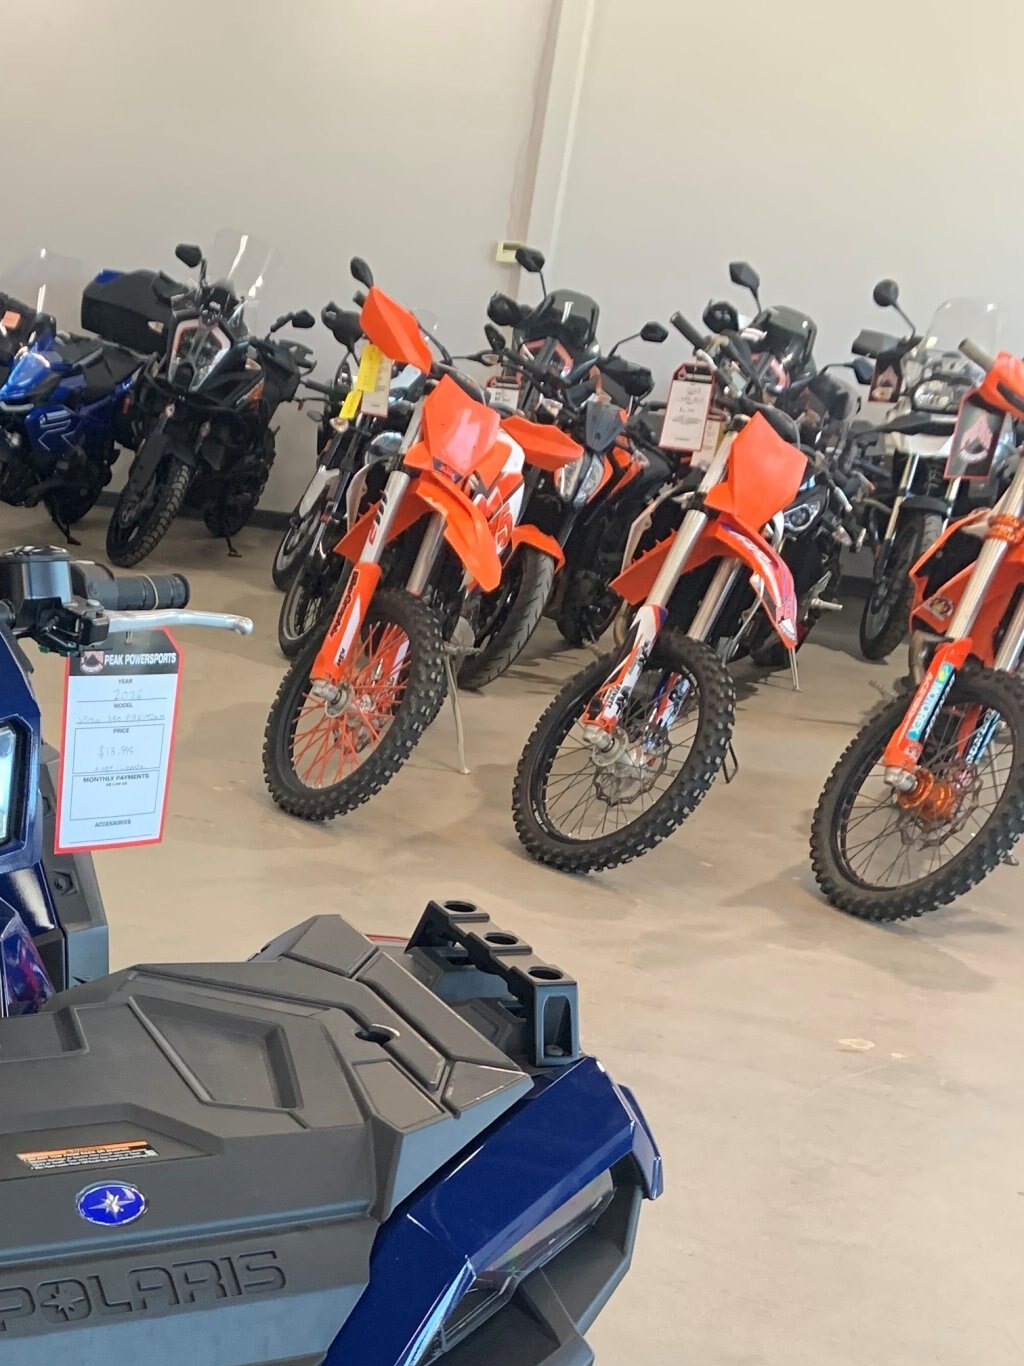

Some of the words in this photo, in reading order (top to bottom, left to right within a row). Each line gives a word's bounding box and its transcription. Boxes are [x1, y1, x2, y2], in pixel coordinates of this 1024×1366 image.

[104, 654, 124, 666] PEAK
[125, 652, 177, 665] POWERSPORTS
[910, 680, 943, 733] MOTOREX
[82, 775, 115, 783] MONTHLY
[116, 773, 150, 781] PAYMENTS
